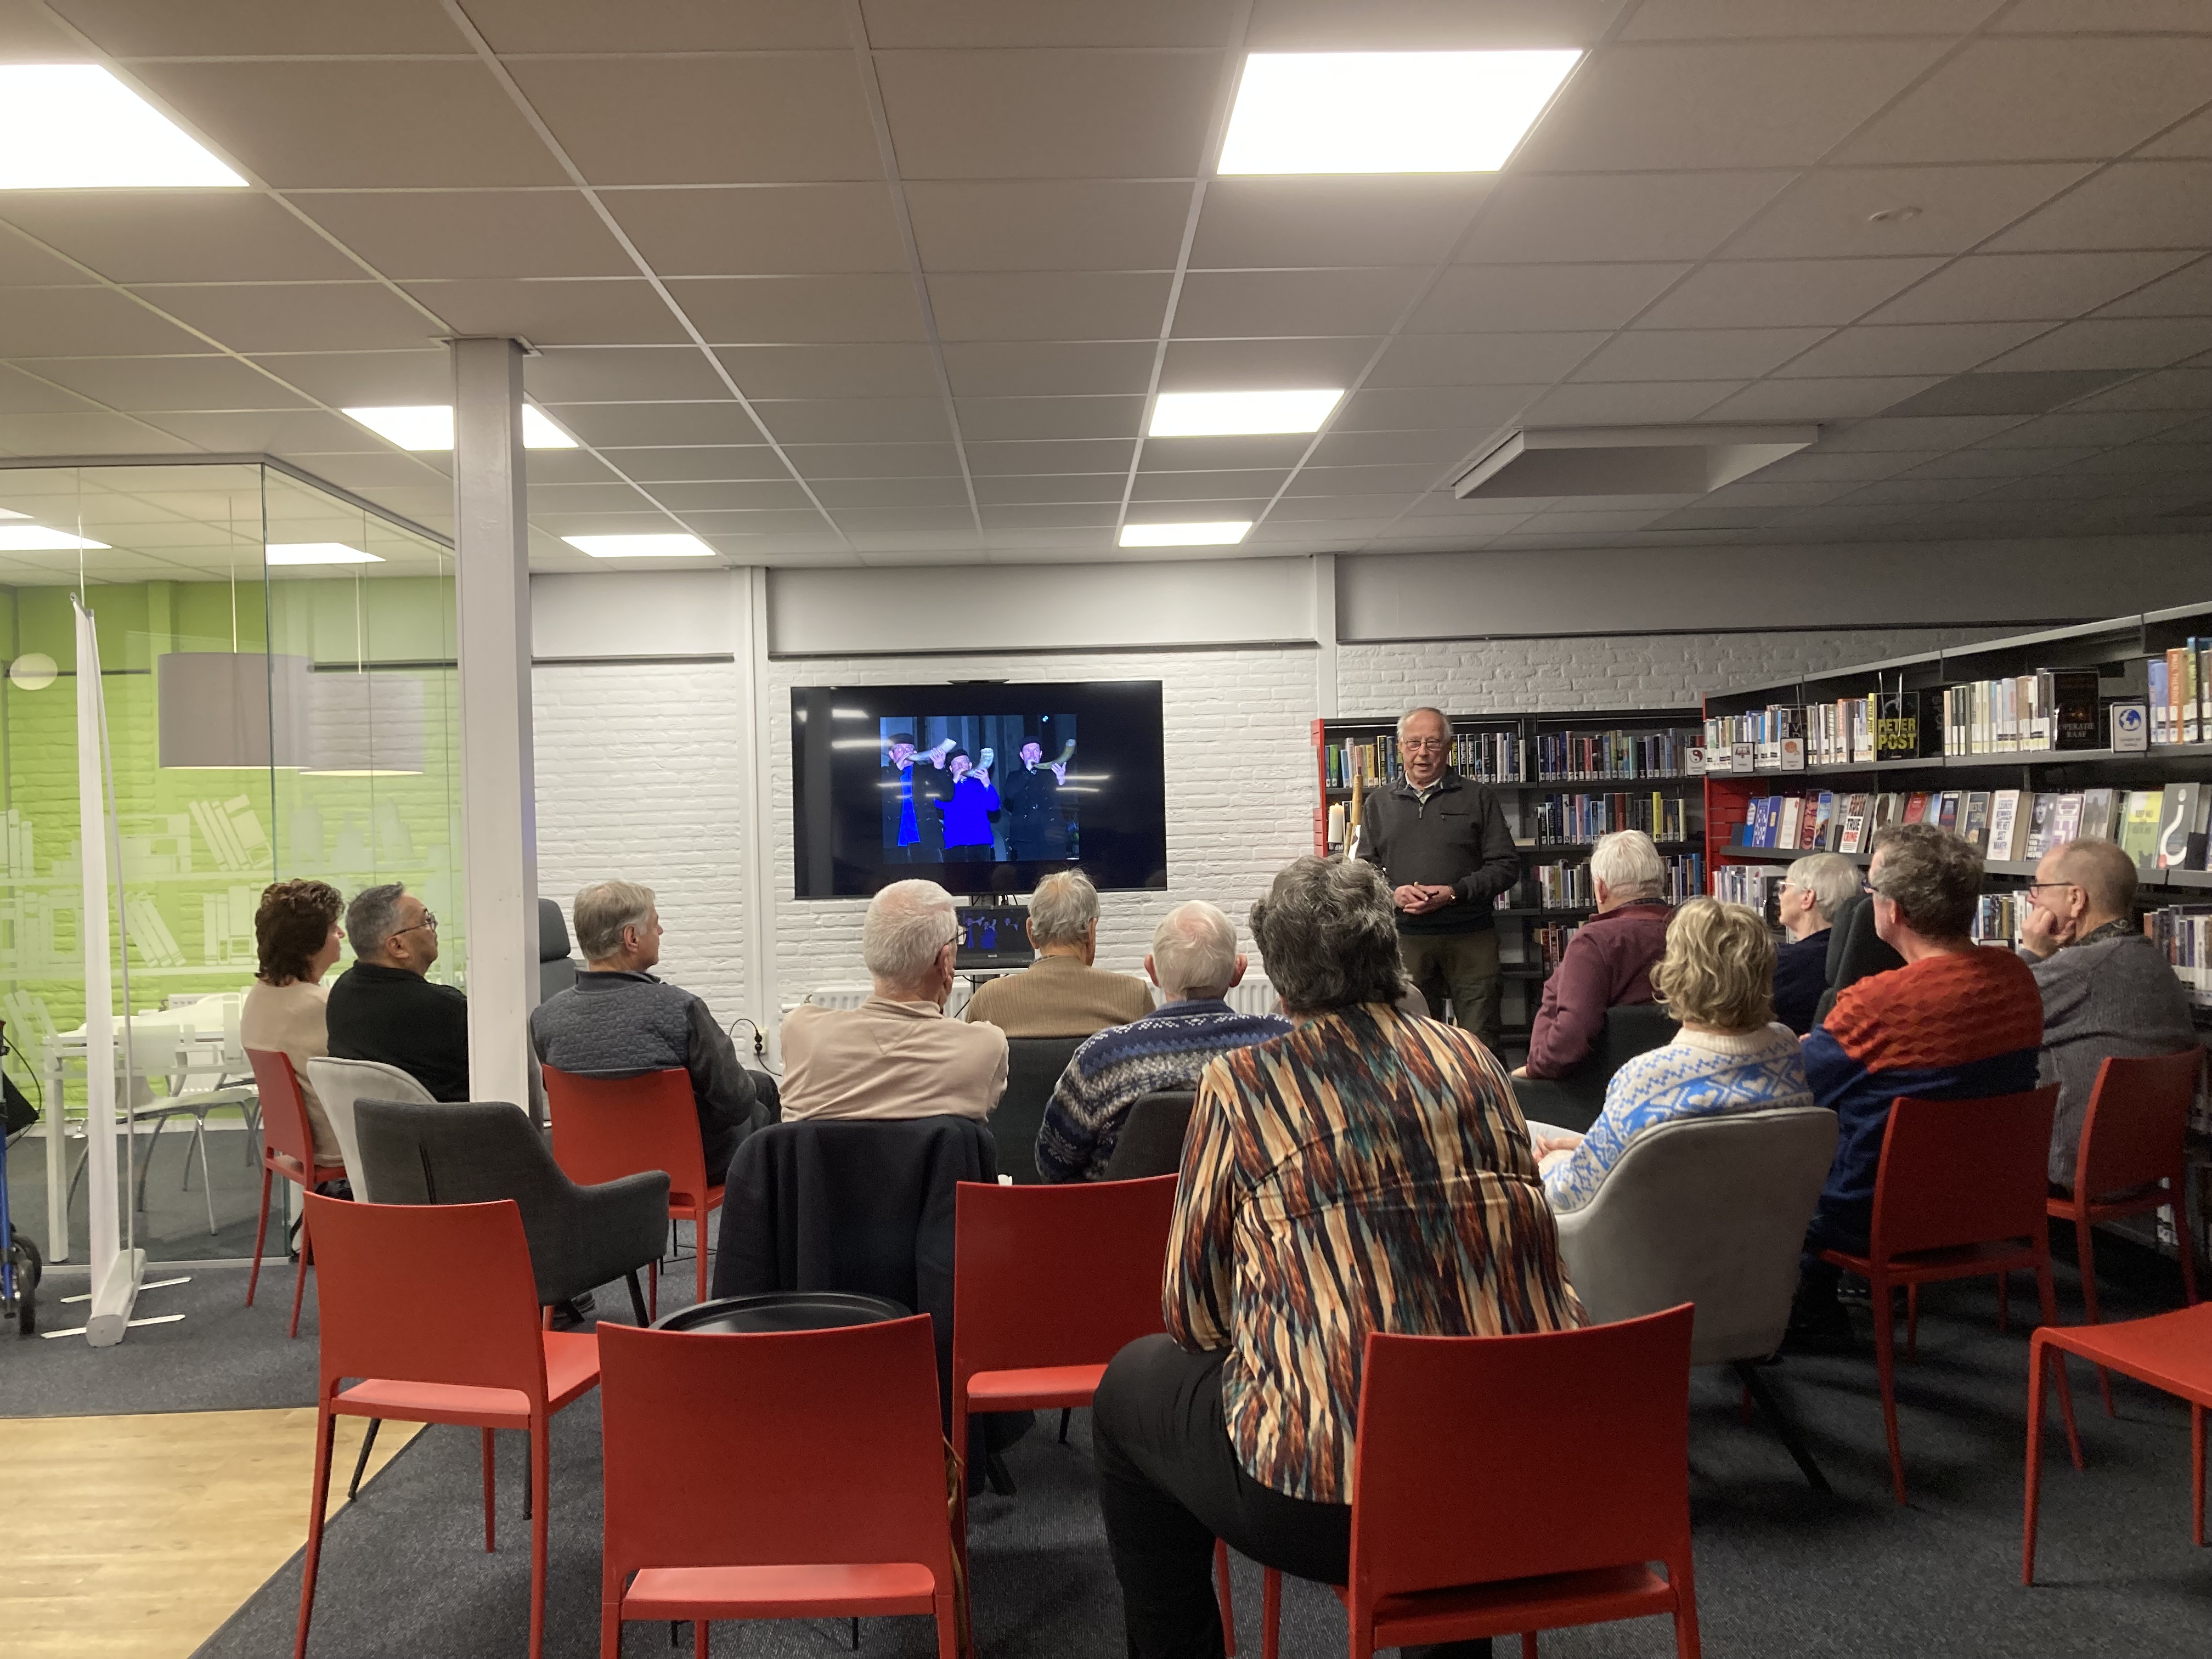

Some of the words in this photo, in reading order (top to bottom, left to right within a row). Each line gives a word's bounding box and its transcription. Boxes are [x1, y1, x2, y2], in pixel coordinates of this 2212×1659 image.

[1878, 718, 1916, 732] PETER
[1877, 733, 1916, 751] POST
[1846, 818, 1861, 831] TRUE
[1843, 831, 1859, 842] CRIME
